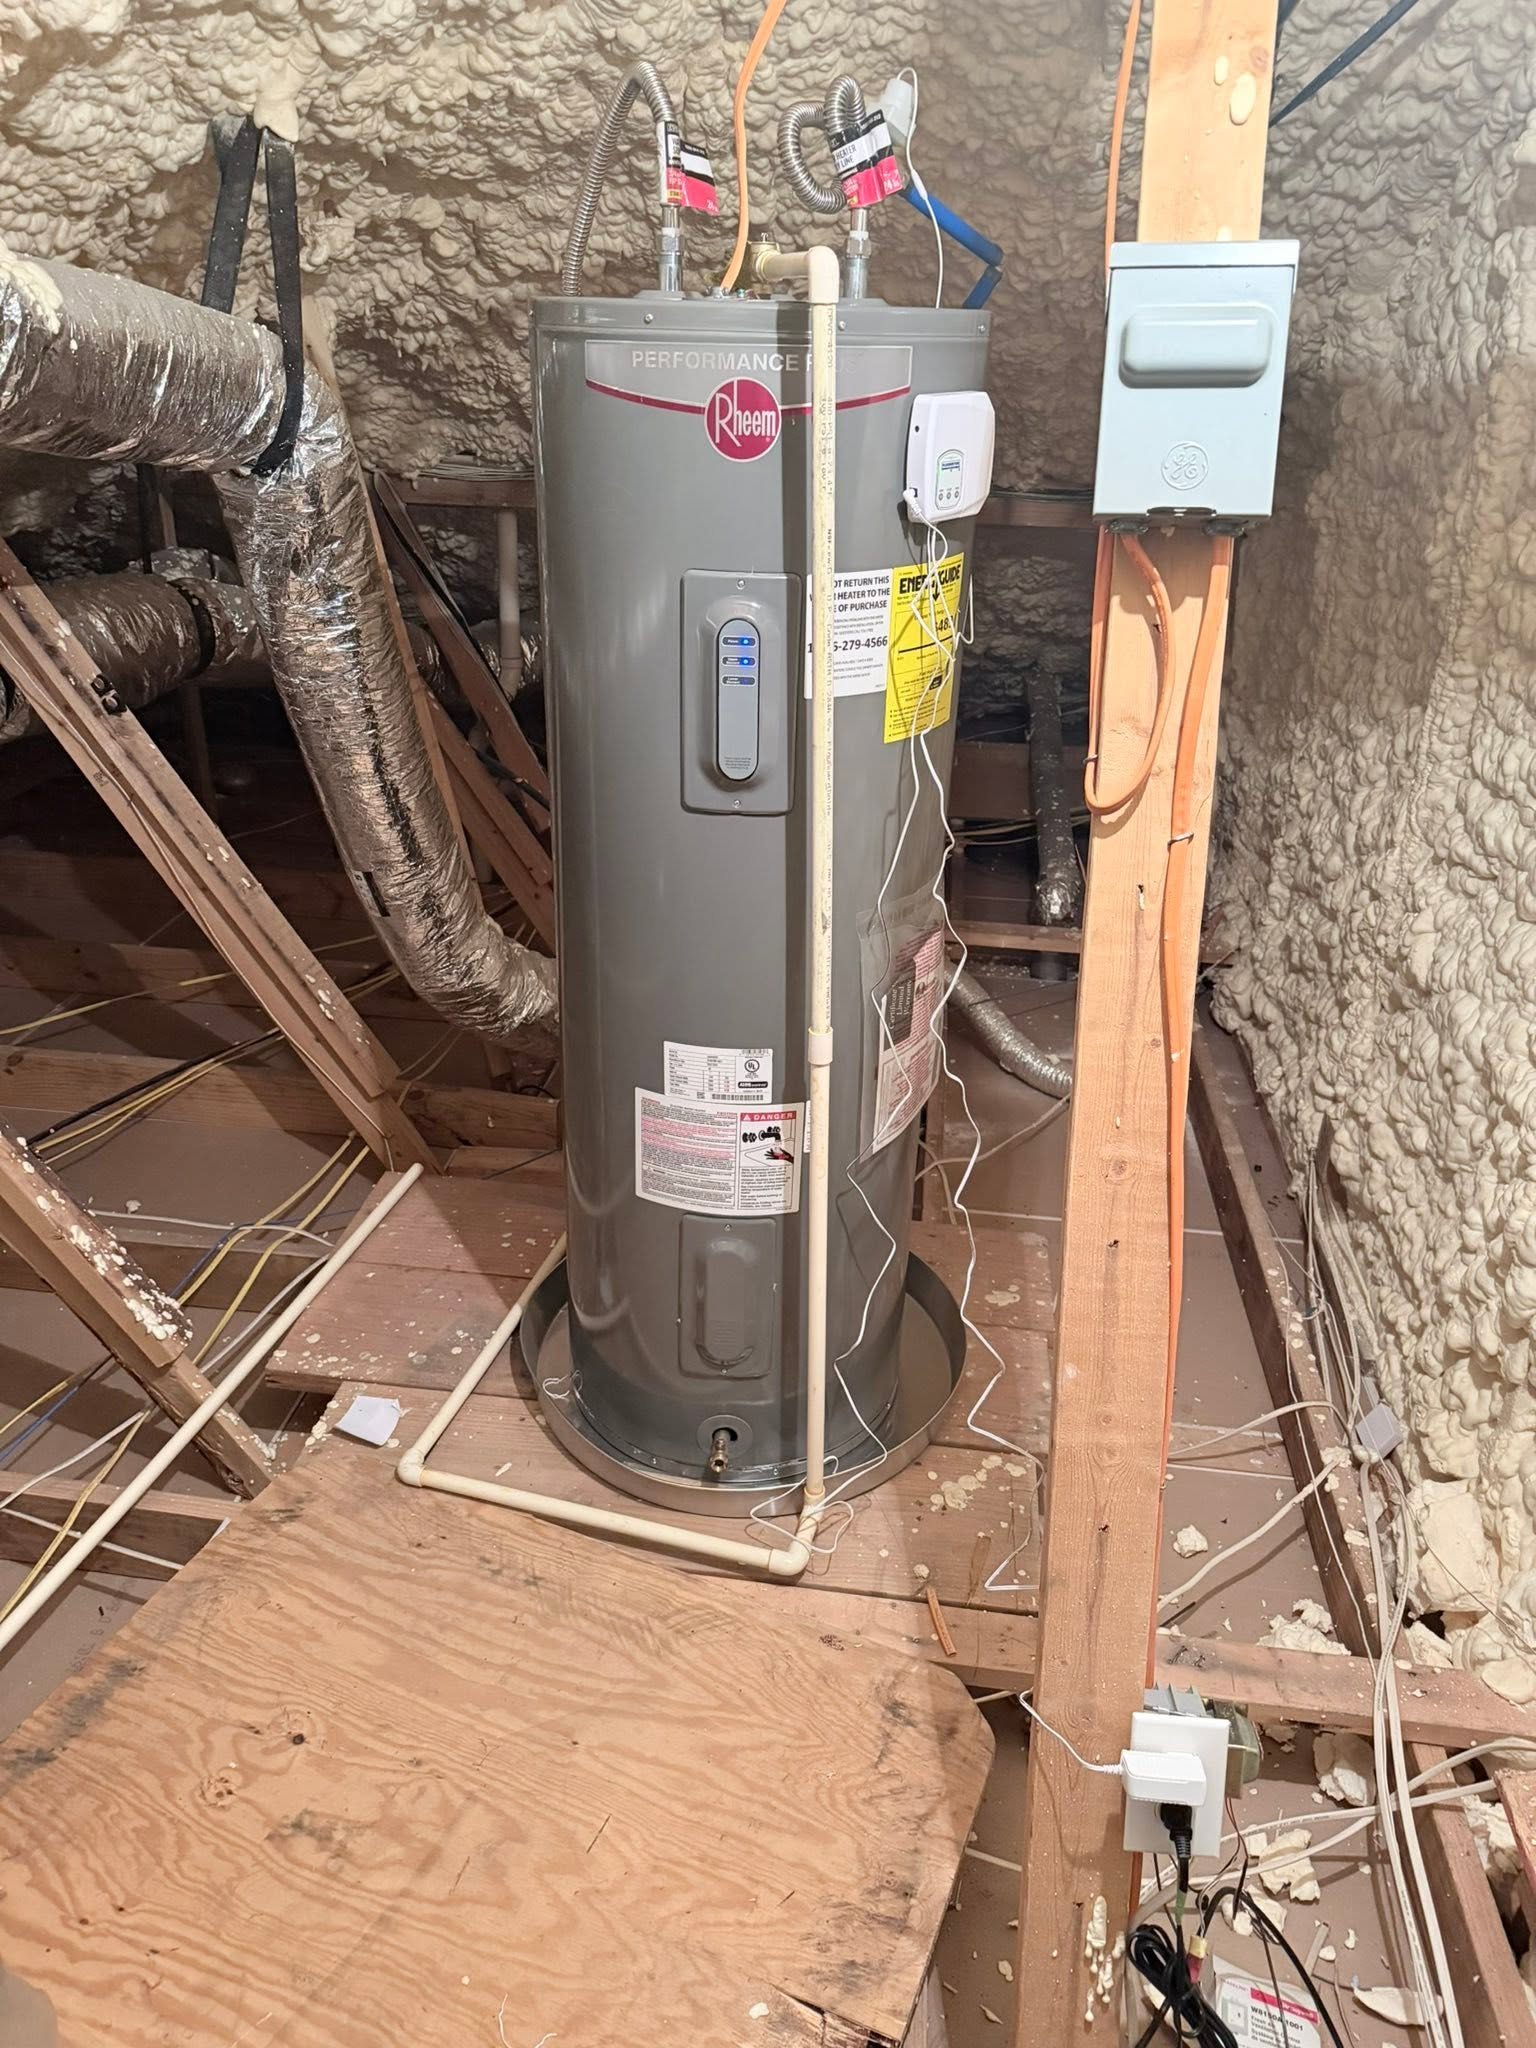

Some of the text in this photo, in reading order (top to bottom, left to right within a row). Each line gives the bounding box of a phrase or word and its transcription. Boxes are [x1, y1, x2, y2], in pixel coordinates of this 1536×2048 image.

[632, 351, 799, 371] PERFORMANCE
[715, 380, 777, 447] Rheem
[844, 578, 873, 588] RETURN
[874, 575, 890, 585] THIS
[837, 587, 891, 600] HEATER TO THE
[838, 603, 850, 613] OF
[850, 600, 888, 612] PURCHASE
[753, 1112, 793, 1121] DANGER
